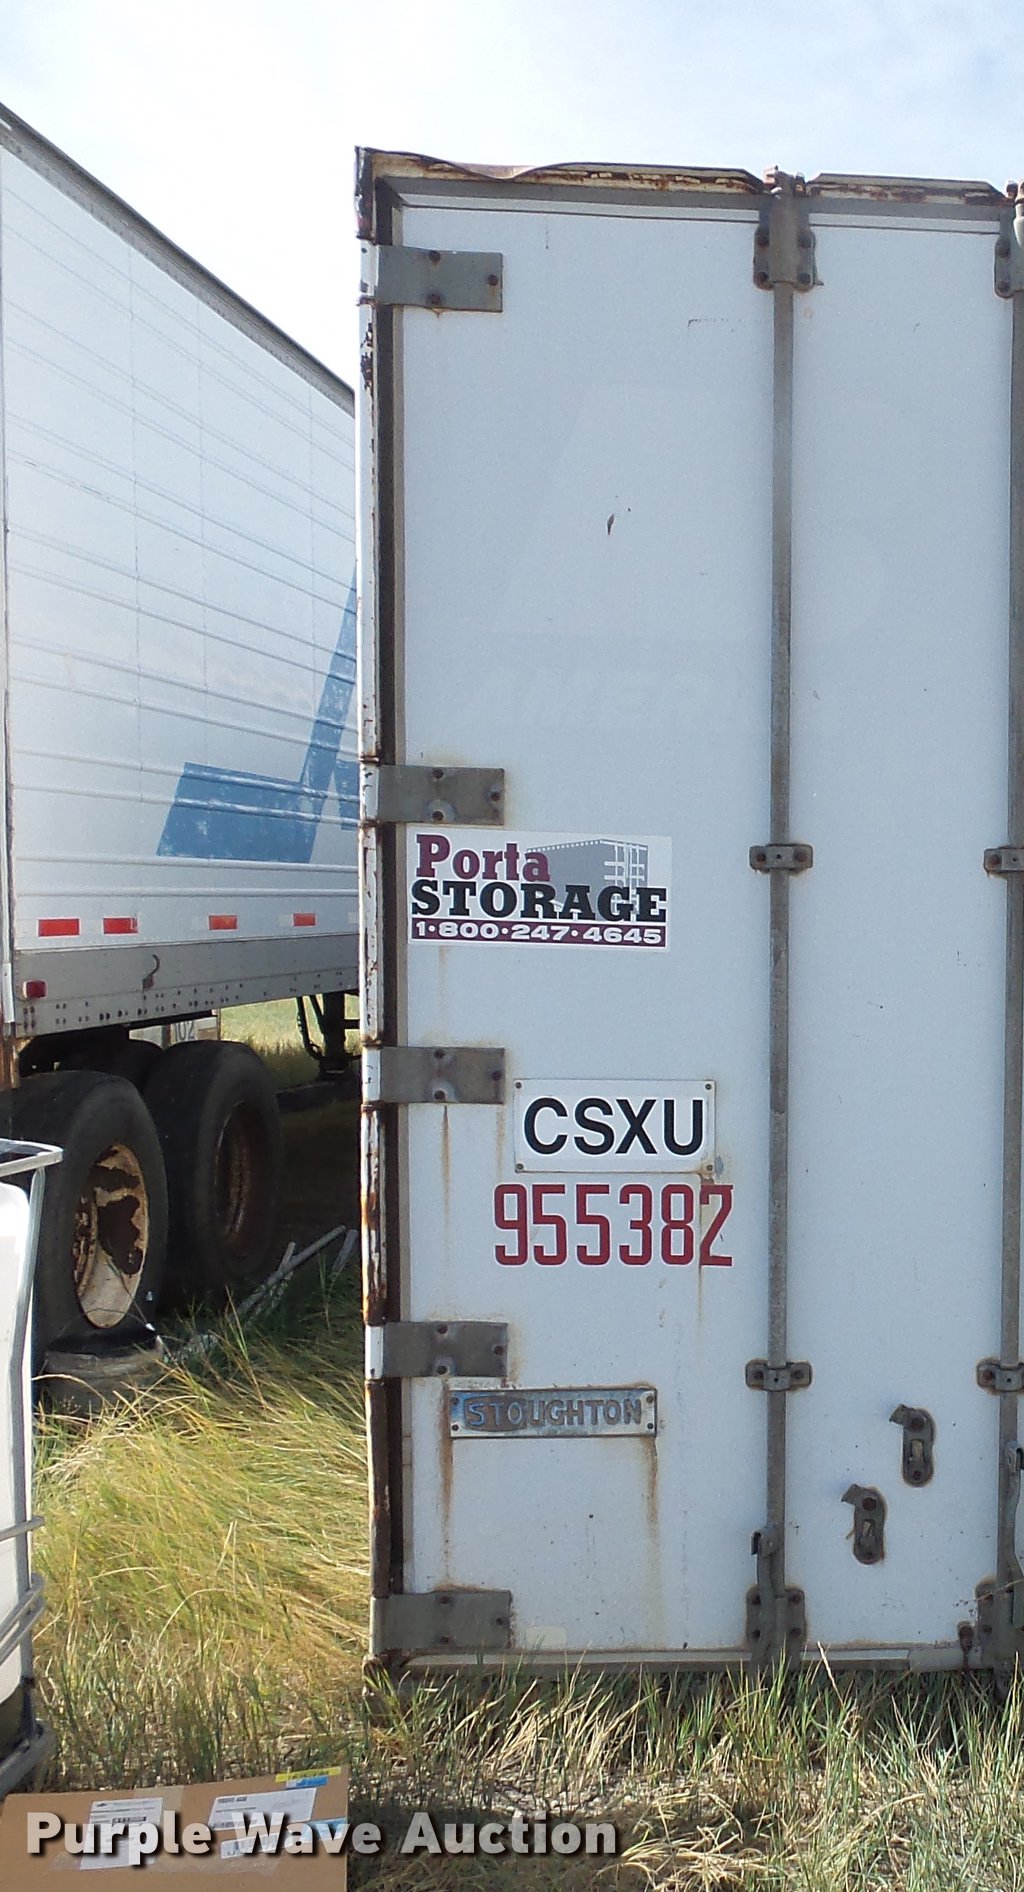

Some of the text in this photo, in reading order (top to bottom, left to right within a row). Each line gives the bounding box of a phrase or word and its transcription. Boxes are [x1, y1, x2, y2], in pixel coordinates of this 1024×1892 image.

[416, 834, 550, 882] Porta
[411, 879, 667, 923] STORAGE
[523, 1097, 704, 1156] CSXU
[493, 1183, 735, 1267] 955382
[468, 1399, 642, 1426] STOUGHTON
